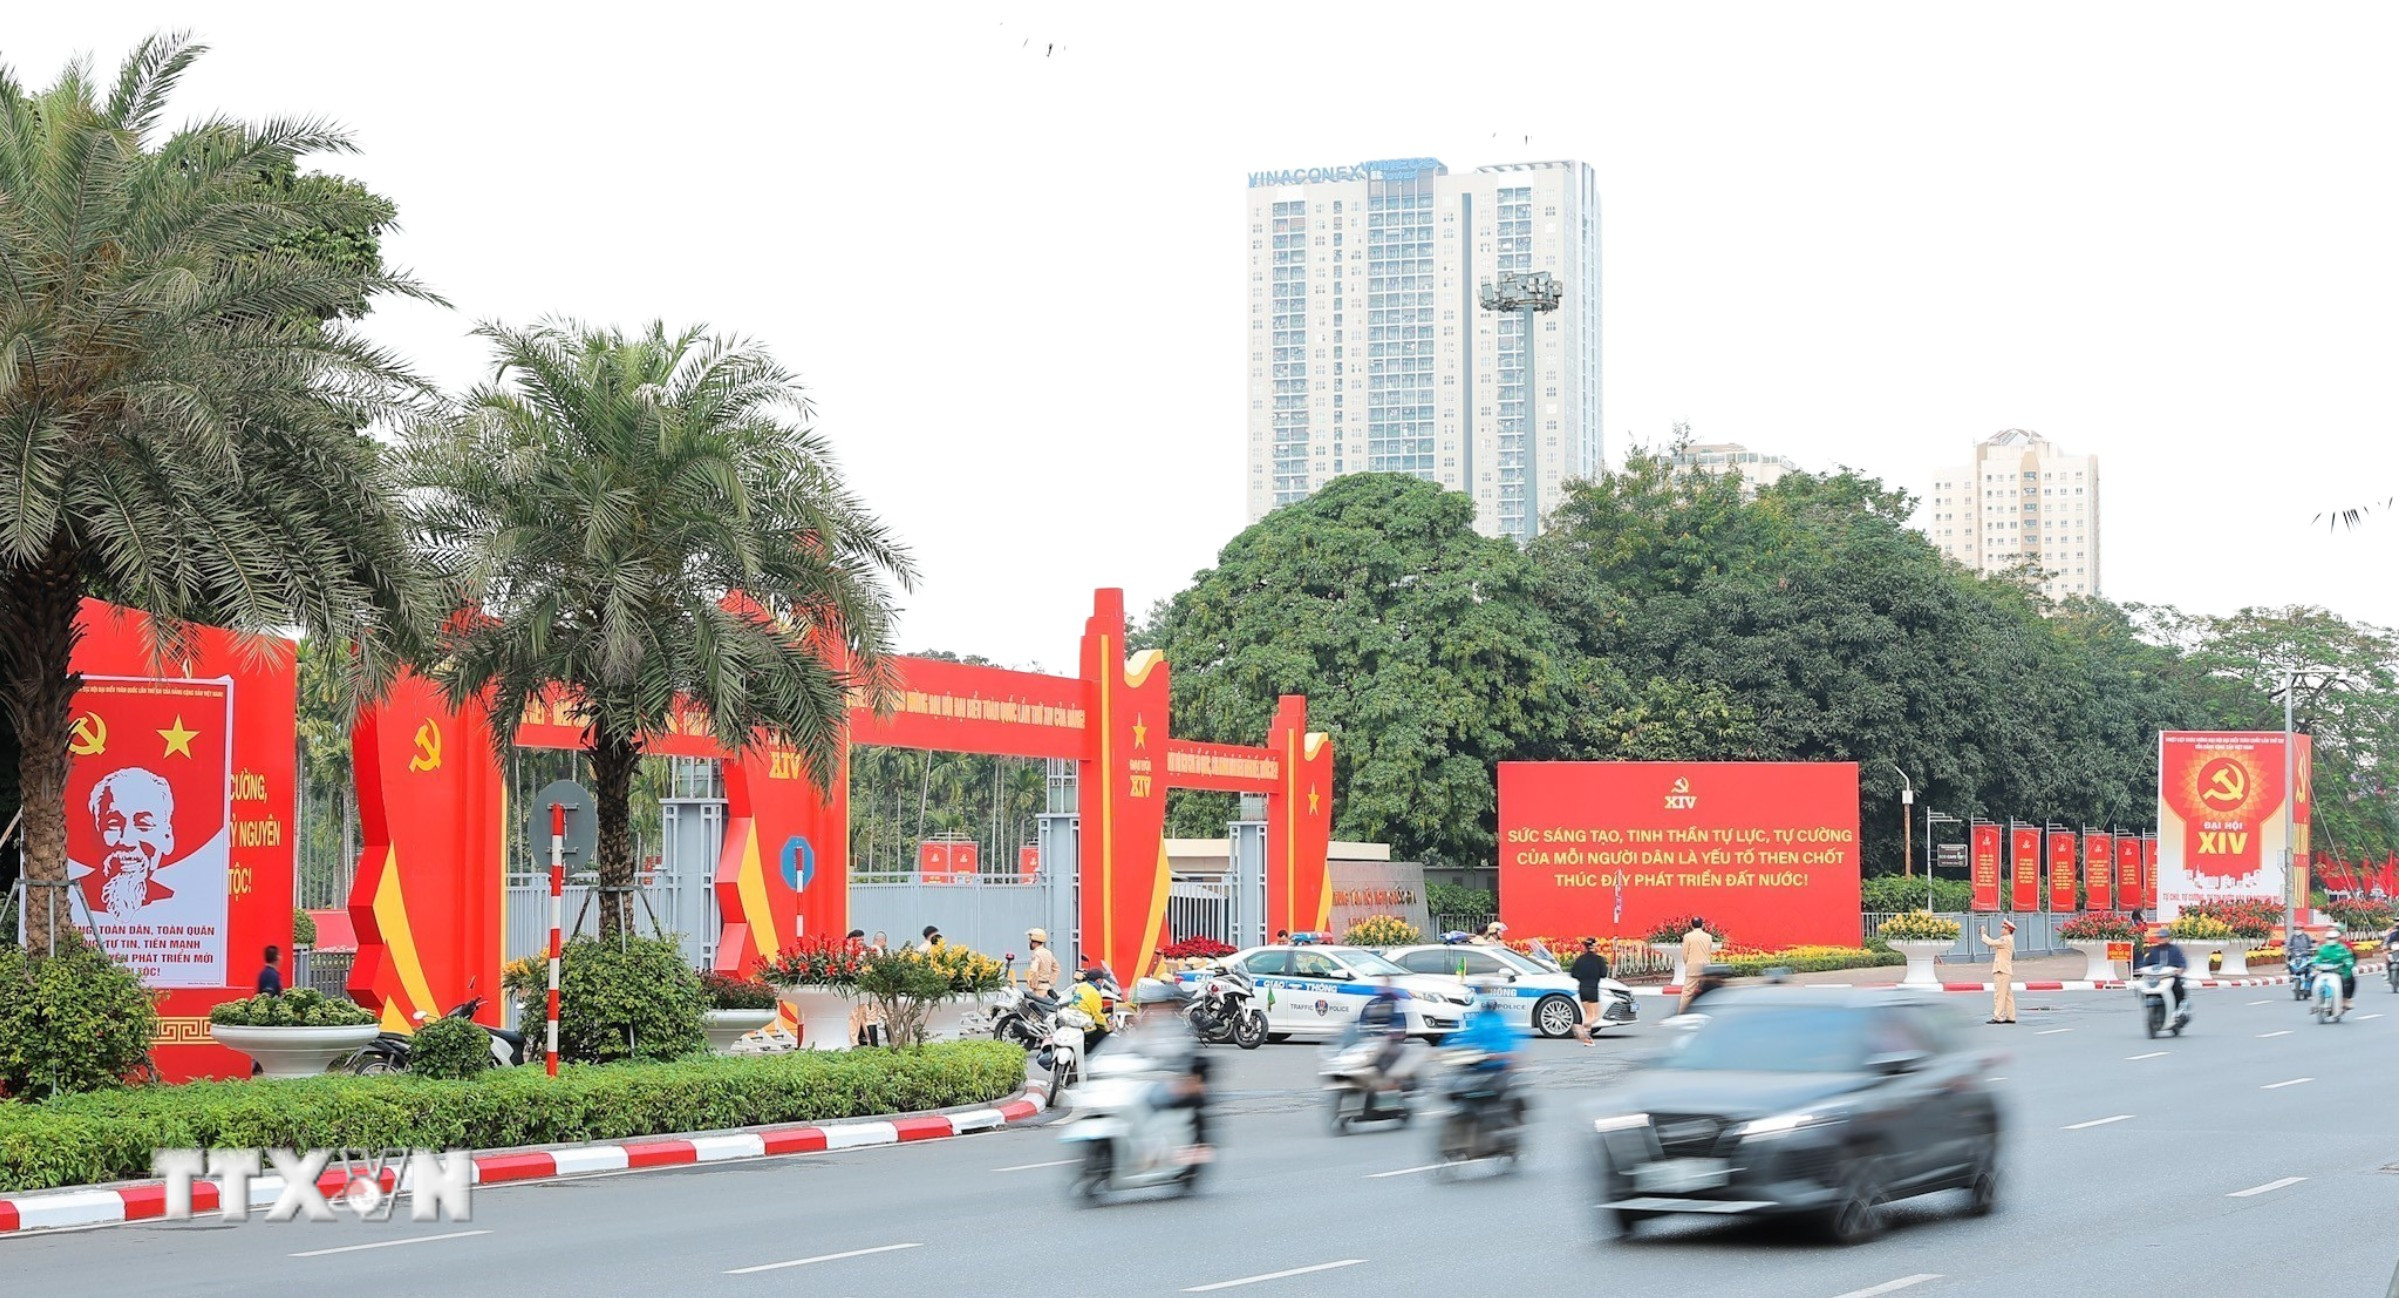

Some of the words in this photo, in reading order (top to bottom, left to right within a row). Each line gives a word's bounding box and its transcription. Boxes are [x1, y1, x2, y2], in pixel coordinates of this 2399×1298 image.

[1247, 164, 1363, 187] VINACONEX
[769, 751, 801, 780] XIV
[1129, 774, 1152, 798] XIV
[1664, 796, 1697, 809] XIV
[239, 813, 280, 847] NGUYÊN
[2204, 821, 2221, 832] ĐẠI
[2225, 820, 2243, 832] HỘI
[1508, 827, 1539, 843] SỨC
[1543, 827, 1587, 843] SÁNG
[1589, 829, 1623, 845] TẠO,
[1626, 829, 1663, 843] TINH
[1666, 826, 1708, 843] THẦN
[1712, 828, 1733, 845] TỰ
[1736, 828, 1770, 845] LỰC,
[1773, 828, 1794, 845] TỰ
[1797, 826, 1852, 843] CƯỜNG
[2198, 832, 2249, 854] XIV
[1517, 848, 1549, 865] CỦA
[1554, 847, 1583, 865] MỖI
[1587, 849, 1637, 865] NGƯỜI
[1642, 849, 1674, 865] DÂN
[1679, 849, 1698, 864] LÀ
[1701, 848, 1731, 865] YẾU
[1735, 848, 1755, 865] TỐ
[1758, 851, 1799, 865] THEN
[1803, 848, 1844, 865] CHỐT
[228, 861, 252, 902] TỘC!
[1554, 871, 1597, 887] THÚC
[1635, 871, 1674, 887] PHÁT
[1677, 869, 1722, 887] TRIỂN
[1725, 870, 1755, 887] ĐẤT
[1758, 871, 1808, 887] NƯỚC!
[100, 923, 126, 935] TOÀN
[129, 923, 153, 937] DÂN,
[157, 924, 184, 936] TOÀN
[187, 924, 215, 937] QUÂN
[106, 938, 119, 950] TỰ
[121, 940, 141, 950] TIN,
[144, 937, 167, 949] TIẾN
[170, 939, 200, 952] MẠNH
[132, 951, 158, 963] PHÁT
[161, 949, 190, 963] TRIỂN
[194, 952, 214, 963] MỚI
[1264, 979, 1284, 990] GIAO
[1305, 982, 1338, 994] THÔNG
[1290, 1003, 1314, 1012] TRAFFIC
[1329, 1005, 1350, 1013] POLICE
[1499, 1003, 1526, 1011] POLICE
